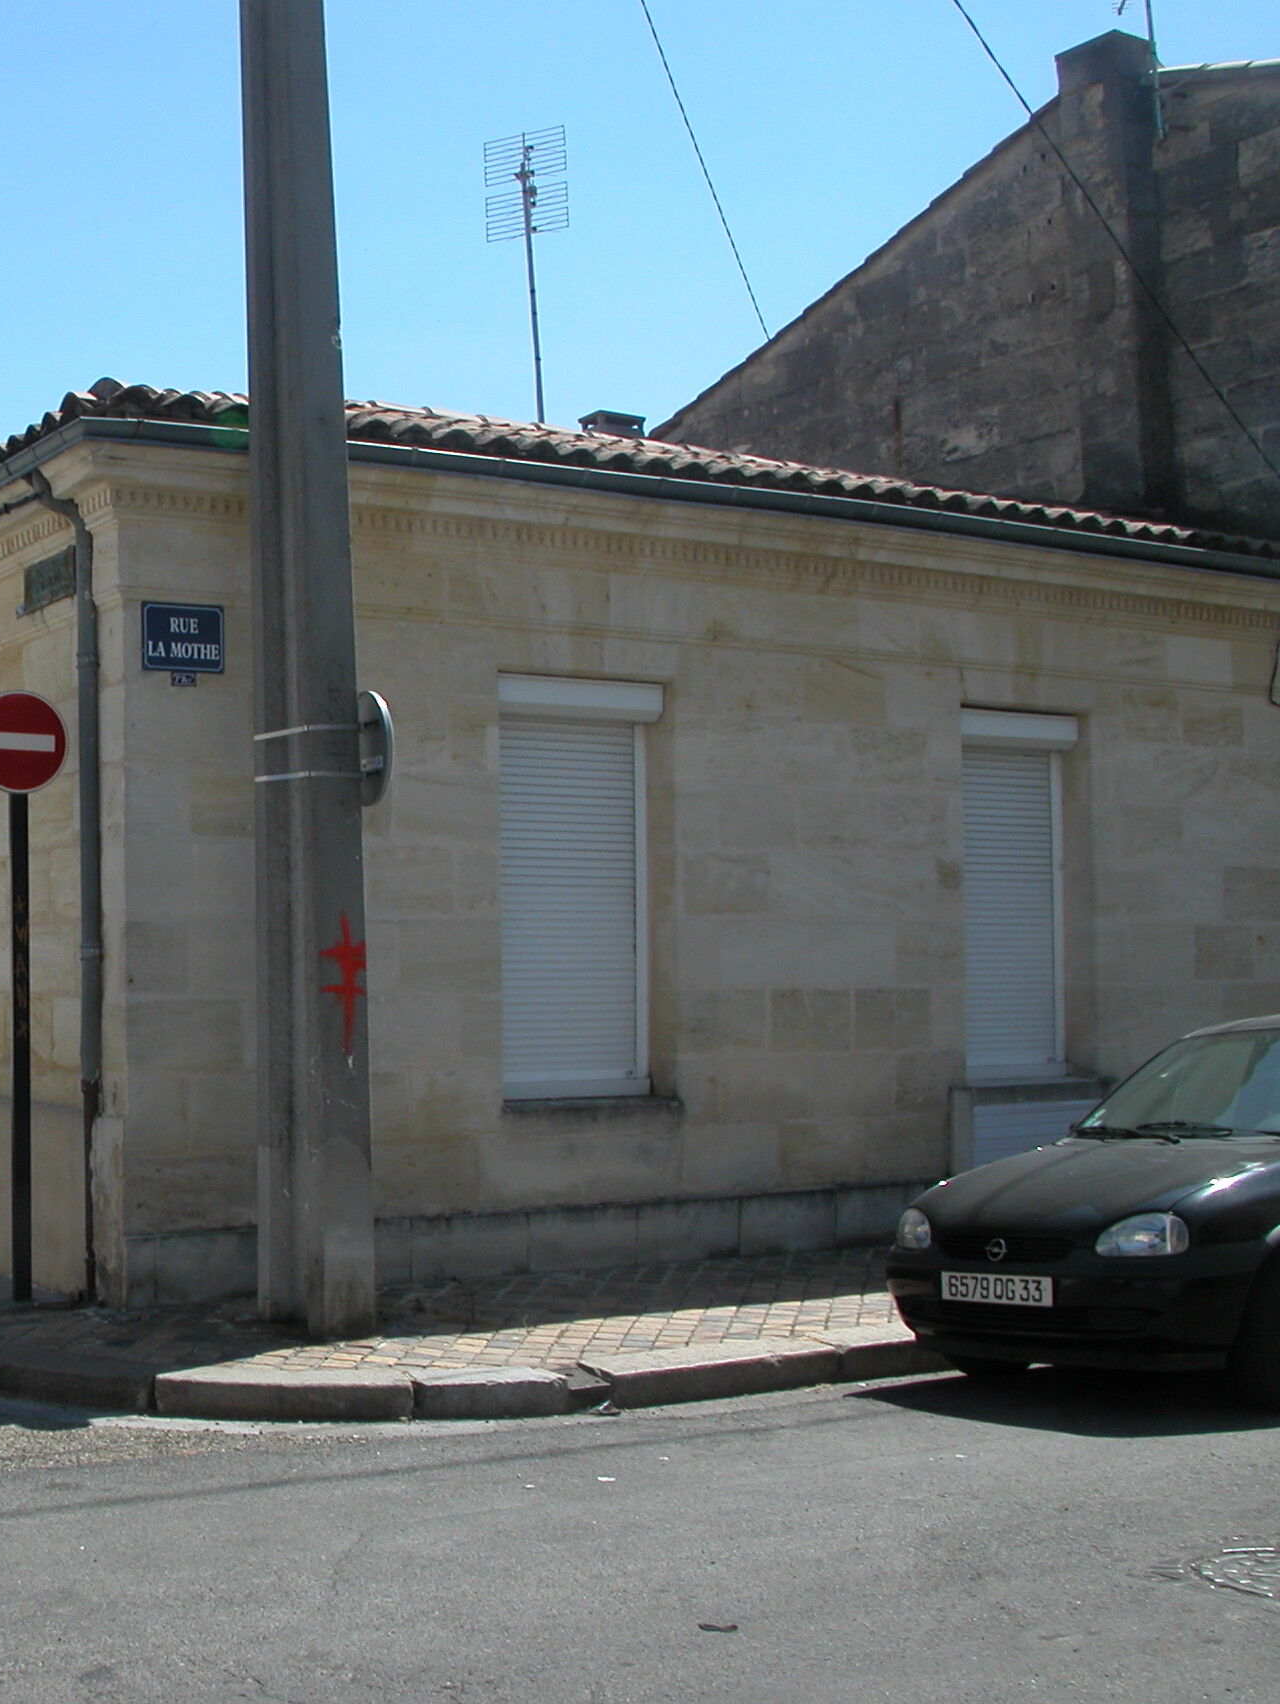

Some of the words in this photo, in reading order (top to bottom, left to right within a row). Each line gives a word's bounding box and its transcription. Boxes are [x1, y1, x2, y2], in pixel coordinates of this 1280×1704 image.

[169, 616, 199, 634] RUE
[147, 640, 166, 657] LA
[169, 642, 220, 660] MOTHE
[948, 1274, 990, 1300] 6579
[1018, 1279, 1043, 1303] 33
